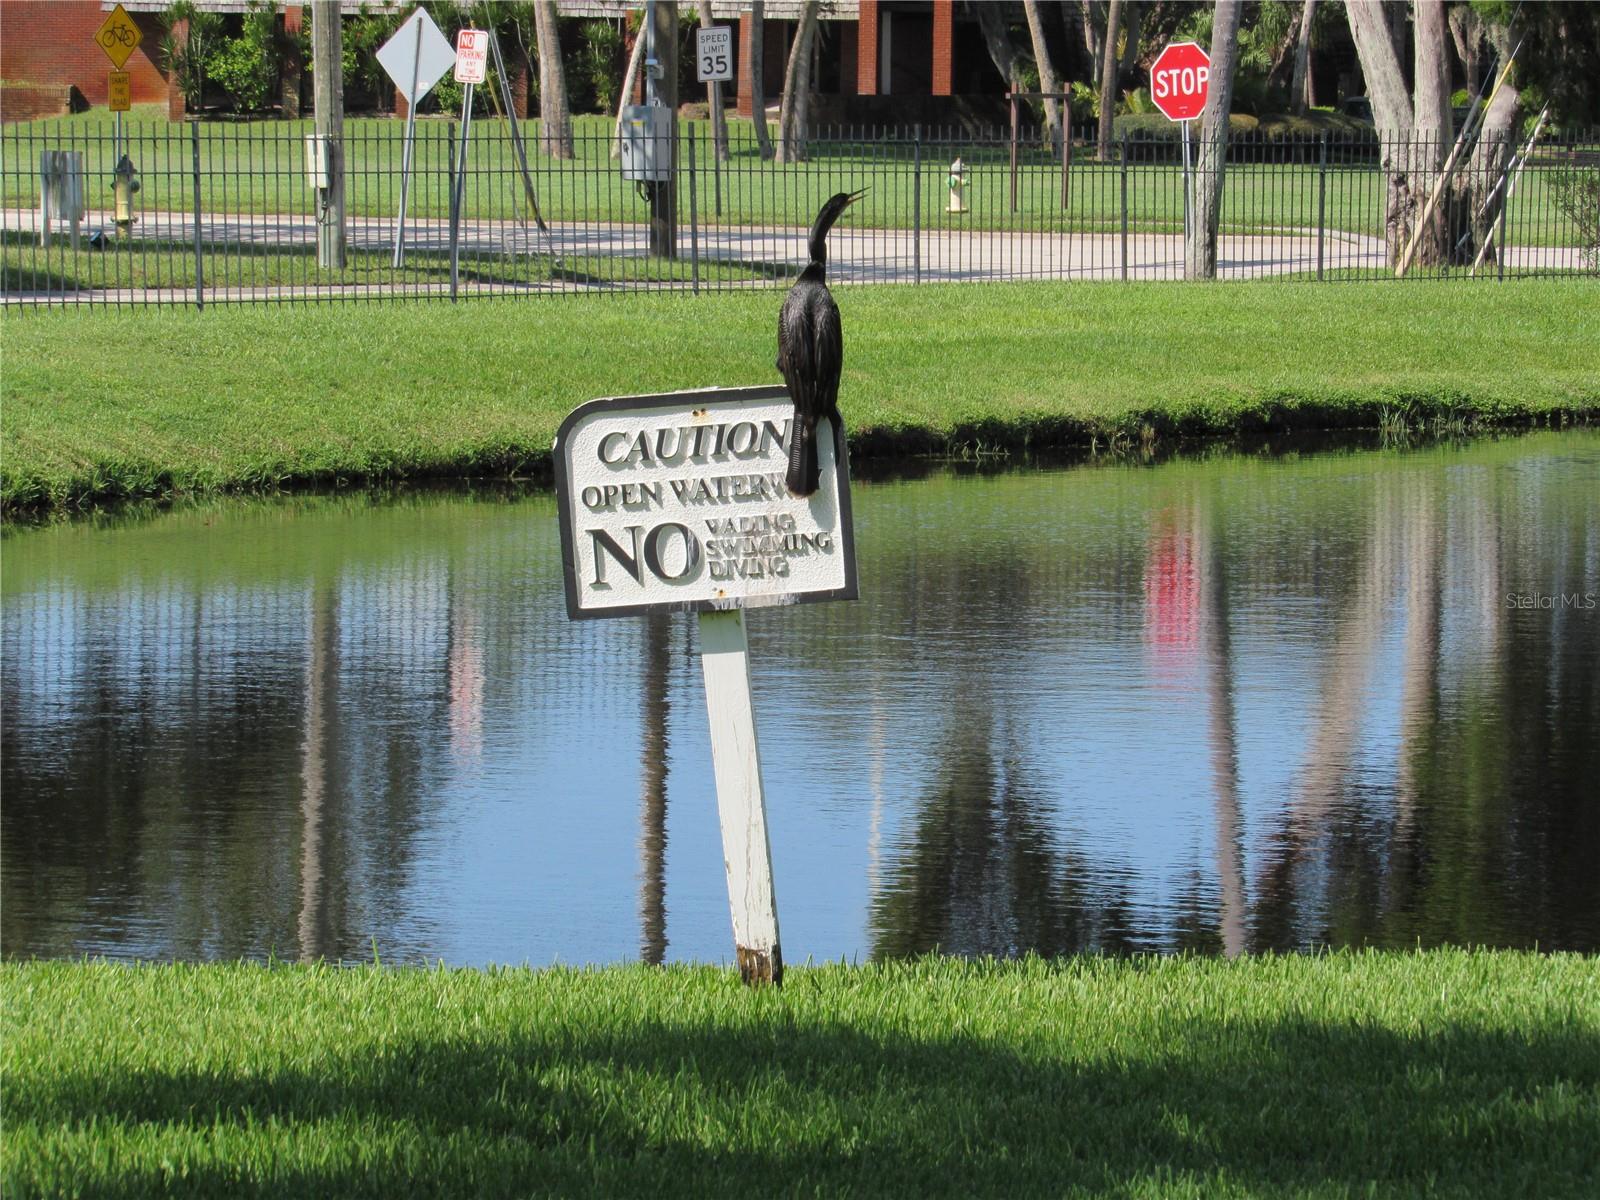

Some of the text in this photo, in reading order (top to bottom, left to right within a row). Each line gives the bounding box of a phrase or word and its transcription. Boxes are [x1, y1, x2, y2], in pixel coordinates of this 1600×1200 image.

[461, 33, 474, 48] NO
[700, 34, 728, 43] SPEED
[703, 45, 725, 54] LIMIT
[459, 50, 484, 60] PARKING
[703, 56, 727, 75] 35
[1156, 66, 1209, 98] STOP
[597, 418, 793, 466] CAUTION
[581, 472, 790, 508] OPEN WATERW
[704, 513, 794, 535] WADING
[585, 522, 700, 585] NO
[705, 532, 831, 556] SWIMMING
[708, 555, 788, 578] DIVING
